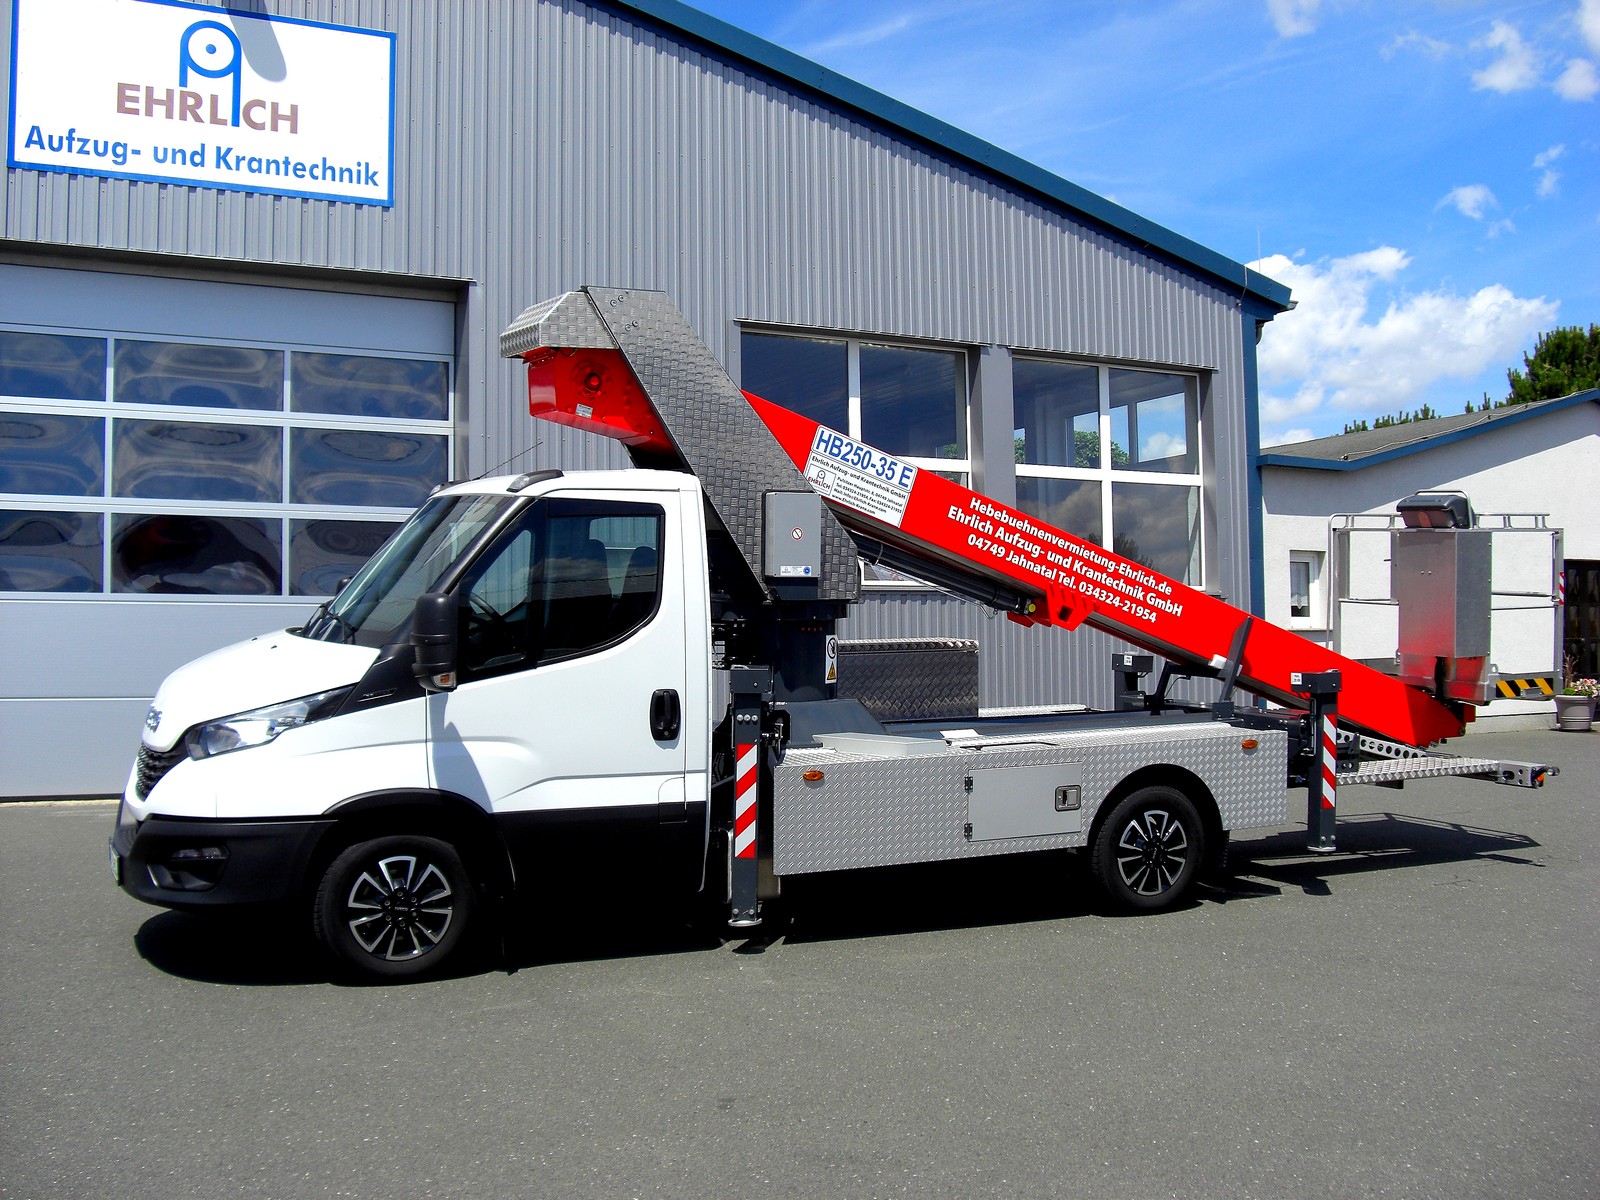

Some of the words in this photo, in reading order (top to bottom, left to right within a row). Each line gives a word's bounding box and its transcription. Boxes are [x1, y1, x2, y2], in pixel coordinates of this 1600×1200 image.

[116, 82, 299, 135] EHRLICH
[24, 125, 142, 165] Aufzug-
[152, 143, 206, 168] und
[214, 147, 379, 187] Krantechnik
[812, 455, 830, 467] Ehrlich
[850, 472, 861, 480] und
[860, 476, 890, 493] Krantechnik
[890, 489, 906, 500] GmbH
[815, 430, 899, 481] HB250-35
[898, 465, 913, 488] E
[948, 504, 993, 535] Ehrlich
[994, 525, 1045, 557] Aufzug-
[1048, 551, 1073, 569] und
[1073, 559, 1145, 601] Krantechnik
[1146, 592, 1183, 617] GmbH
[970, 497, 1172, 595] Hebebuehnenvermietung-Ehrlich.de
[968, 534, 1006, 558] 04749
[1006, 550, 1057, 580] Jahnatal
[1058, 571, 1076, 589] Tel.
[1079, 581, 1157, 623] 034324-21954
